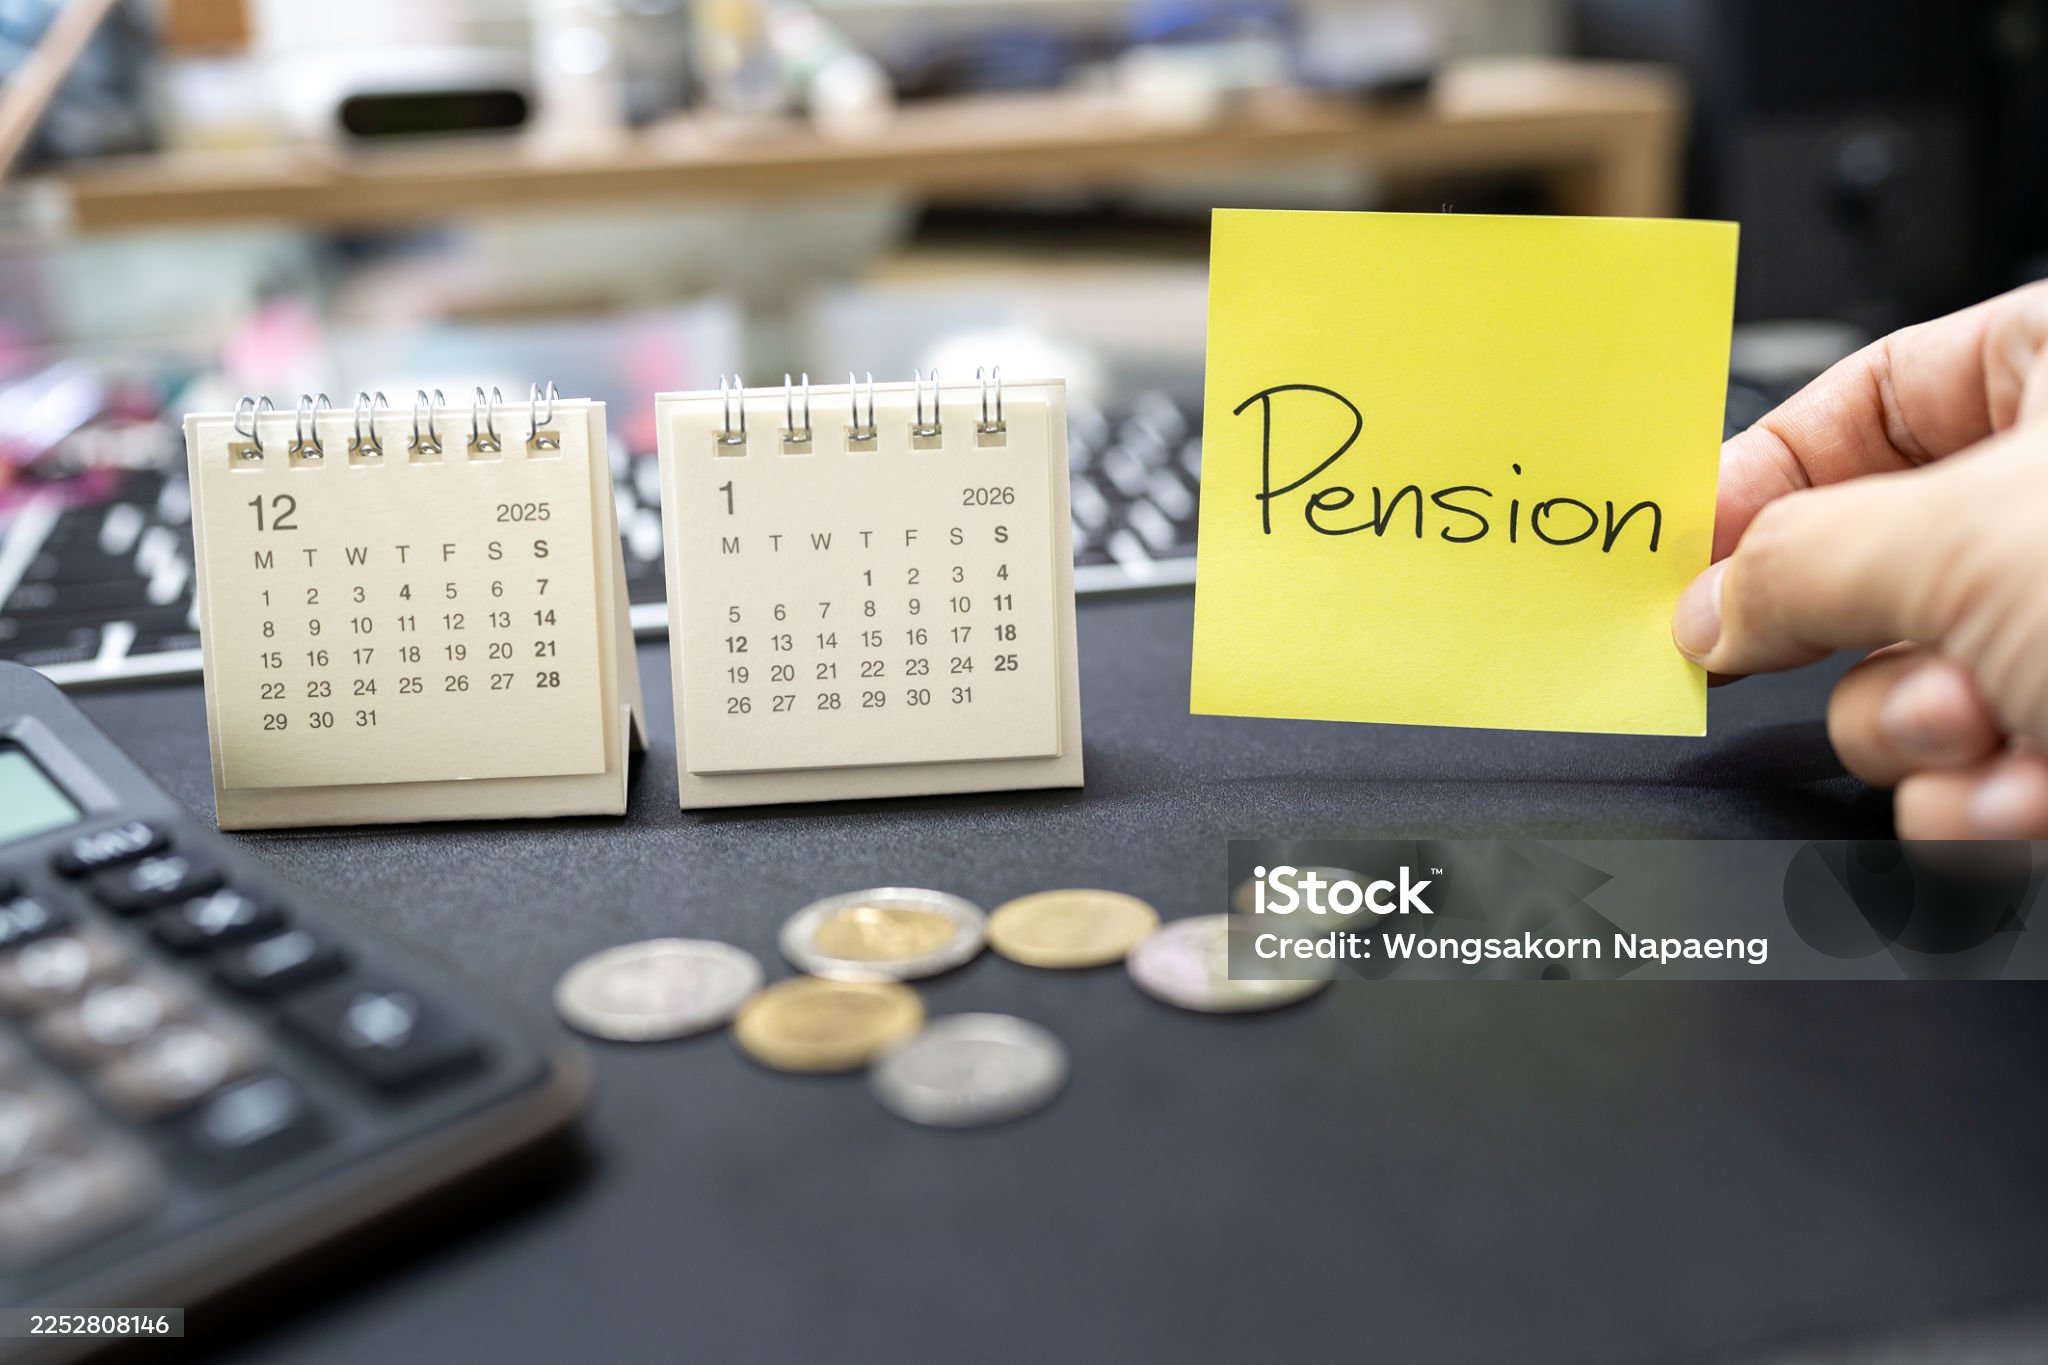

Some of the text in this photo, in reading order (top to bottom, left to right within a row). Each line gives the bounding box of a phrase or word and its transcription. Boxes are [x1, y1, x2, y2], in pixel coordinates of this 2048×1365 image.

[1233, 384, 1661, 553] Pension
[247, 493, 551, 532] 12 2025
[719, 480, 1015, 516] 1 2026
[254, 539, 549, 570] M T W T F S S
[722, 525, 1009, 555] M T W T F S S
[863, 563, 1009, 587] 1 2 3 4
[262, 578, 549, 607] 1 2 3 4 5 6 7
[262, 609, 557, 638] 8 9 10 11 12 13 14
[728, 593, 1013, 624] 5 6 7 8 9 10 11
[725, 623, 1017, 654] 12 13 14 15 16 17 18
[260, 639, 556, 669] 15 16 17 18 19 20 21
[727, 654, 1019, 684] 19 20 21 22 23 24 25
[260, 670, 561, 700] 22 23 24 25 26 27 28
[727, 686, 972, 715] 26 27 28 29 30 31
[263, 709, 377, 731] 29 30 31
